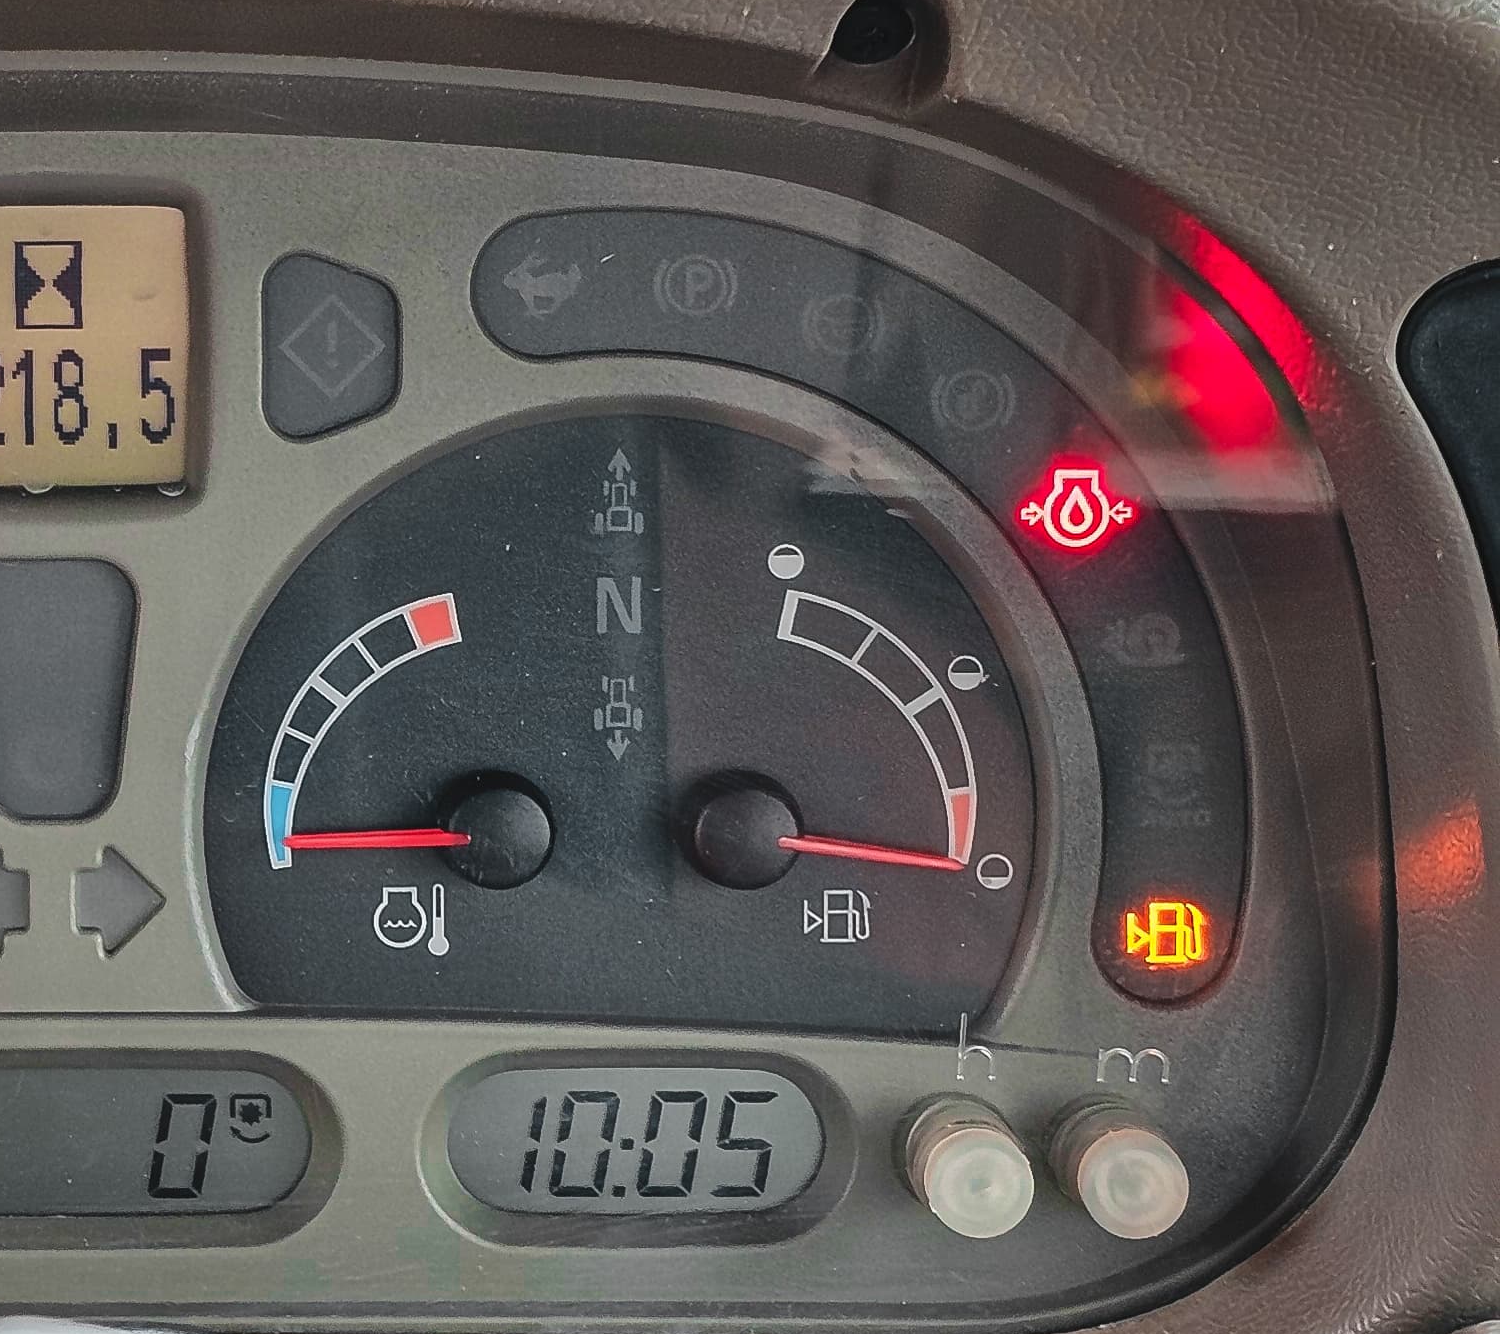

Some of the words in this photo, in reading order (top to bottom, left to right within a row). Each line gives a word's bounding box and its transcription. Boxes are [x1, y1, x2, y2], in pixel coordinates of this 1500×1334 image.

[596, 575, 644, 636] N
[956, 1012, 997, 1081] h
[1097, 1047, 1171, 1084] m
[146, 1093, 218, 1200] 0
[517, 1090, 779, 1200] 10:05
